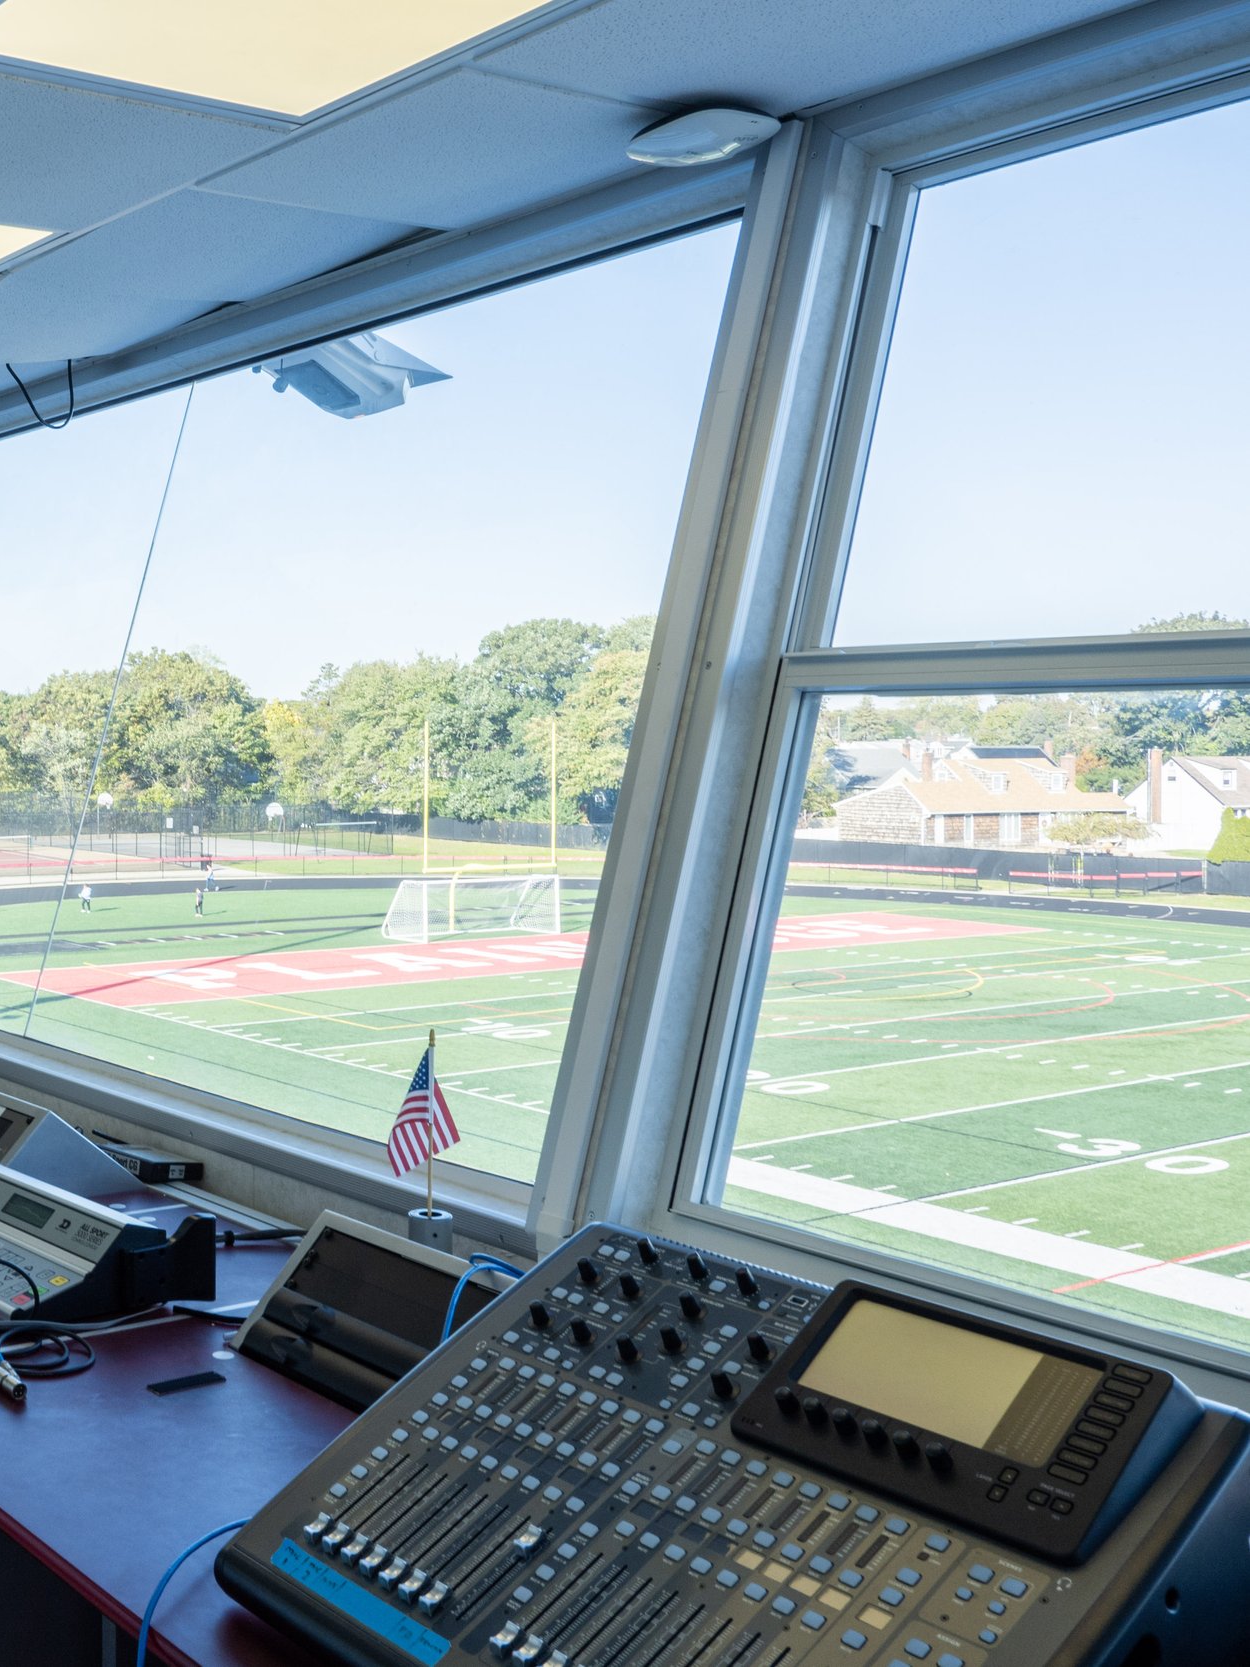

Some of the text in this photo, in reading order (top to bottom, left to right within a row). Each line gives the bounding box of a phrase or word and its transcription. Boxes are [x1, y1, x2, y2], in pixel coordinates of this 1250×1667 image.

[128, 1158, 138, 1171] CG
[1057, 1138, 1230, 1175] 30
[80, 1223, 91, 1232] ALL
[90, 1227, 110, 1239] SPORT
